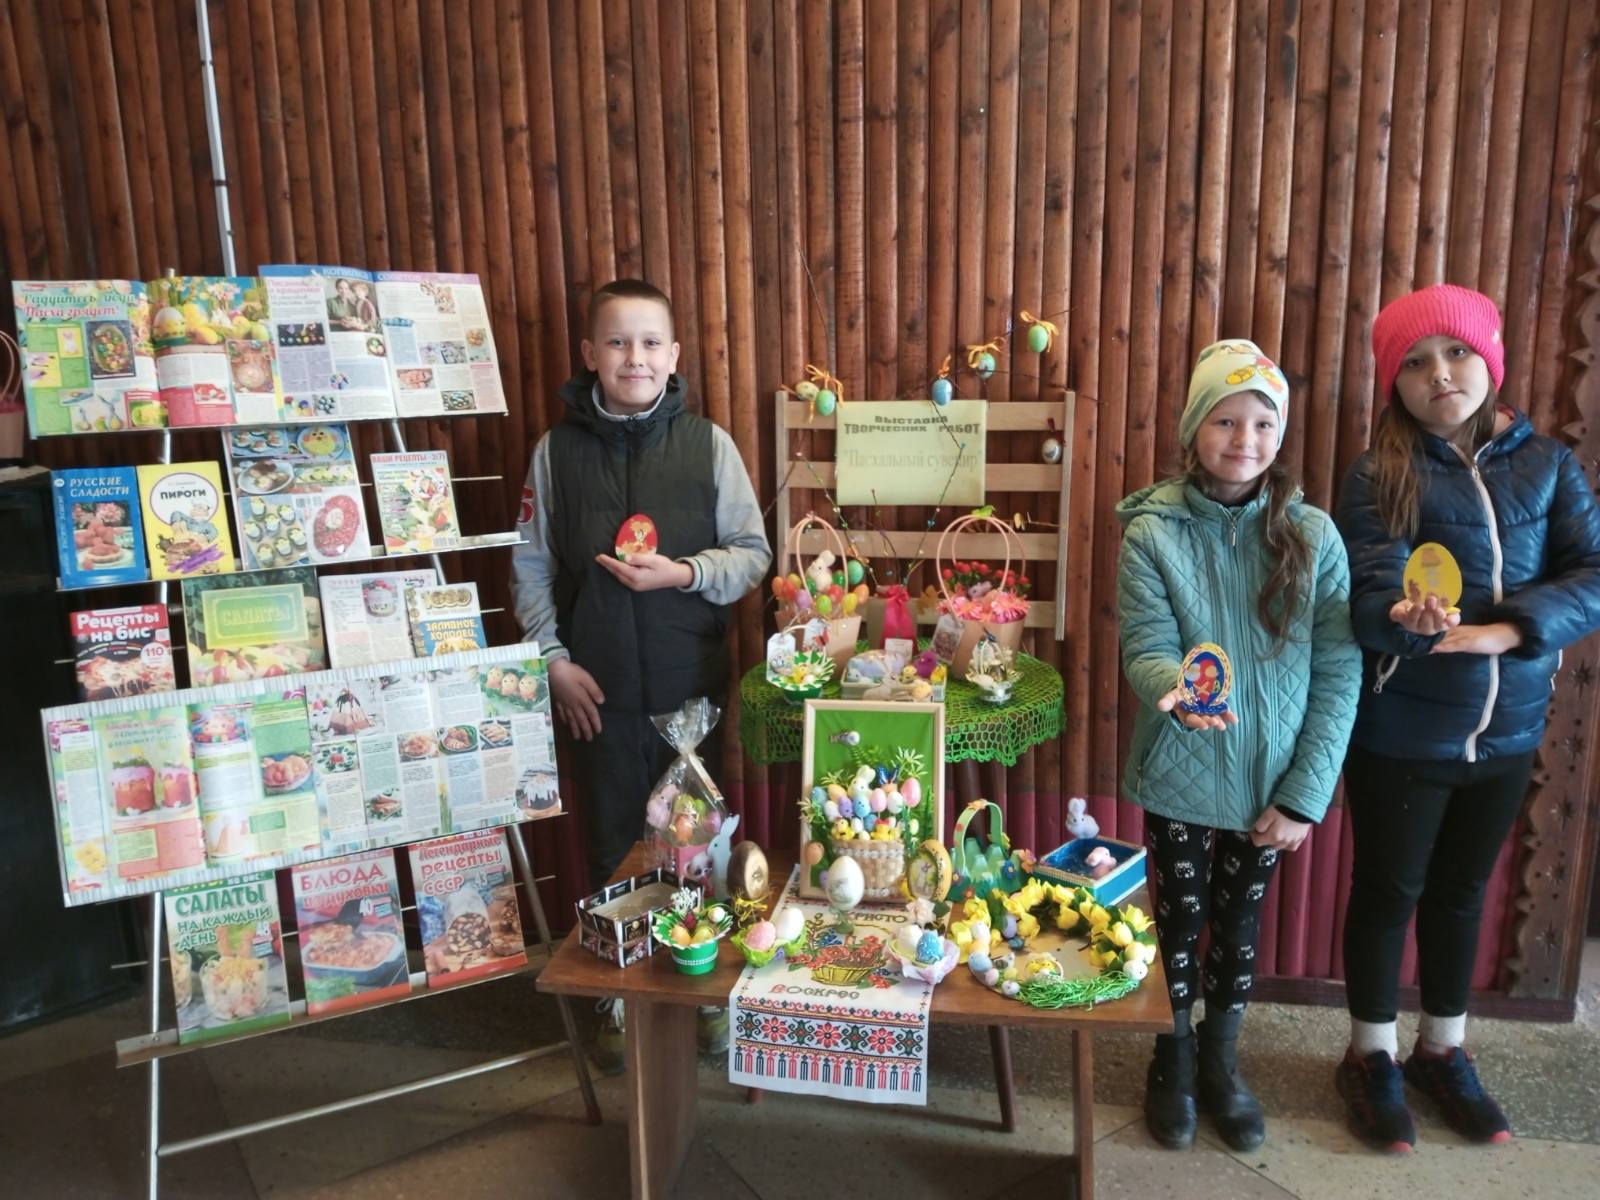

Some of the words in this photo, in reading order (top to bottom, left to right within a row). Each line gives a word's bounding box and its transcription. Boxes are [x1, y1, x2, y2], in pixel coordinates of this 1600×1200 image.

[844, 423, 927, 434] ТВОРЧЕСКИХ
[938, 423, 981, 434] РАБОТ
[874, 415, 948, 424] ВЫСТАВКА
[394, 453, 427, 463] РЕЦЕПТЫ
[70, 476, 122, 488] РУССКИЕ
[70, 486, 129, 498] СЛАДОСТИ
[160, 488, 207, 500] ПИРОГИ
[76, 612, 160, 630] Рецепты
[90, 631, 113, 643] на
[116, 625, 152, 640] бис
[145, 646, 164, 657] 110
[419, 835, 501, 862] Легендарные
[421, 851, 501, 879] рецепты
[300, 863, 384, 892] БЛЮДА
[423, 875, 464, 896] СССР
[175, 883, 266, 917] САЛАТЫ
[177, 920, 199, 933] НА
[203, 905, 272, 927] КАЖДЫЙ
[178, 933, 217, 951] ДЕНЬ
